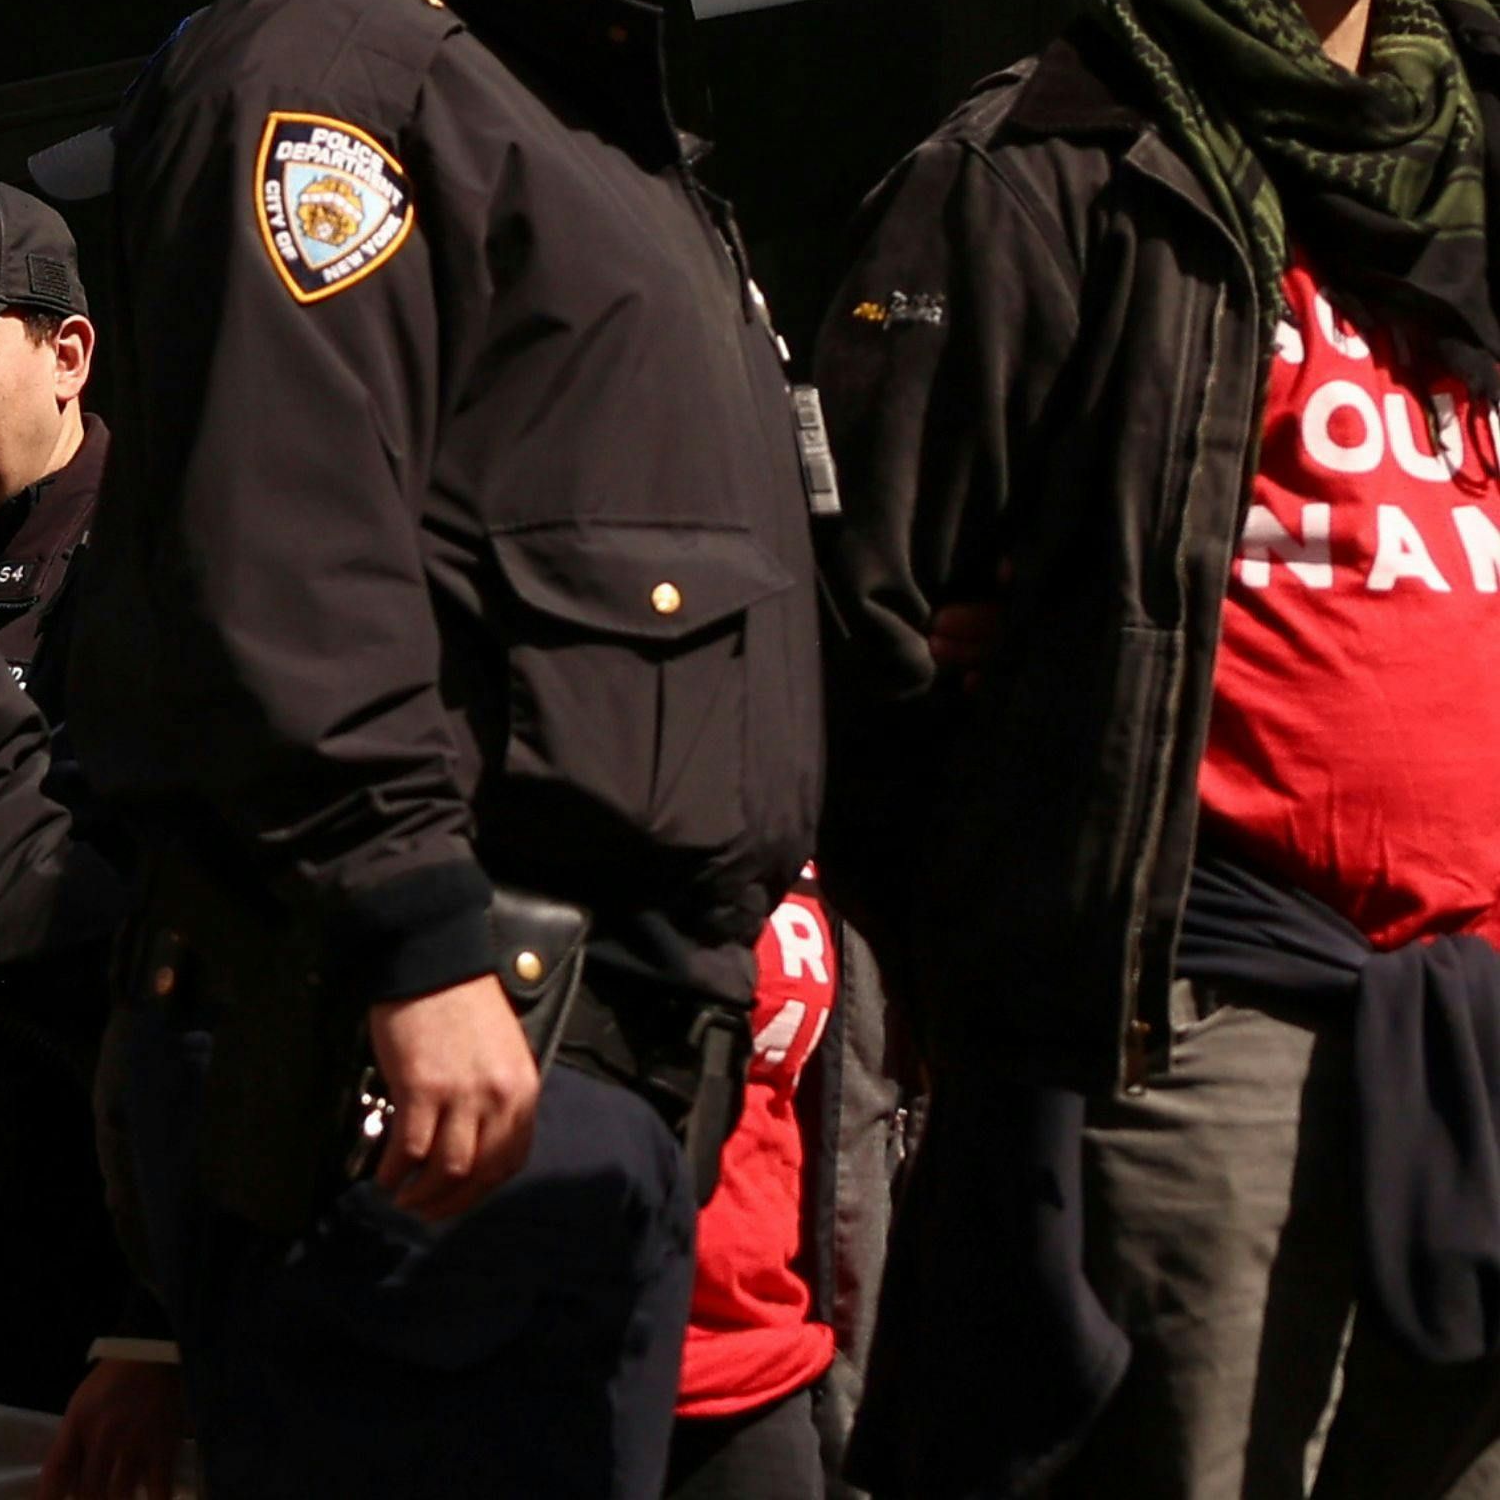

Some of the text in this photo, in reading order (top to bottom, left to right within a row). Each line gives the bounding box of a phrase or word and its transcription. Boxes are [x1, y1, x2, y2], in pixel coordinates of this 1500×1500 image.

[274, 140, 404, 207] DEPARTMENT
[310, 127, 385, 173] POLICE
[264, 180, 299, 262] CITY OF
[321, 213, 403, 283] NEW YORK
[1302, 380, 1500, 482] OU
